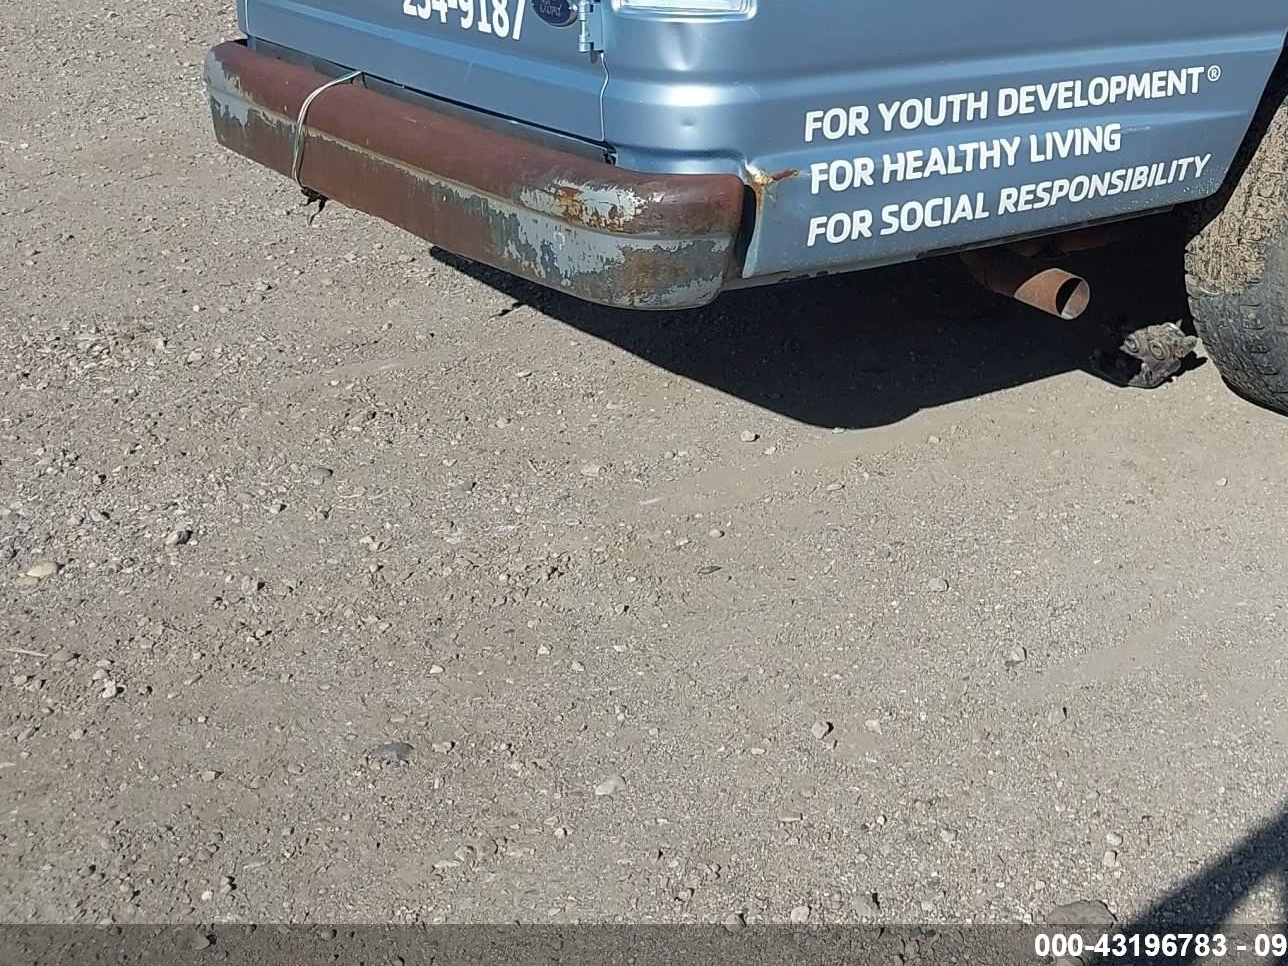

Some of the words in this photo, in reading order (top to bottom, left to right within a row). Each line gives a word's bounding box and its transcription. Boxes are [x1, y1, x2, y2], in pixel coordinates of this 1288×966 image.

[804, 105, 869, 142] FOR
[878, 90, 988, 132] YOUTH
[810, 159, 875, 195] FOR
[882, 137, 1021, 185] HEALTHY
[1029, 123, 1121, 163] LIVING
[807, 213, 873, 247] FOR
[880, 198, 990, 235] SOCIAL
[997, 153, 1212, 215] RESPONSIBILITY
